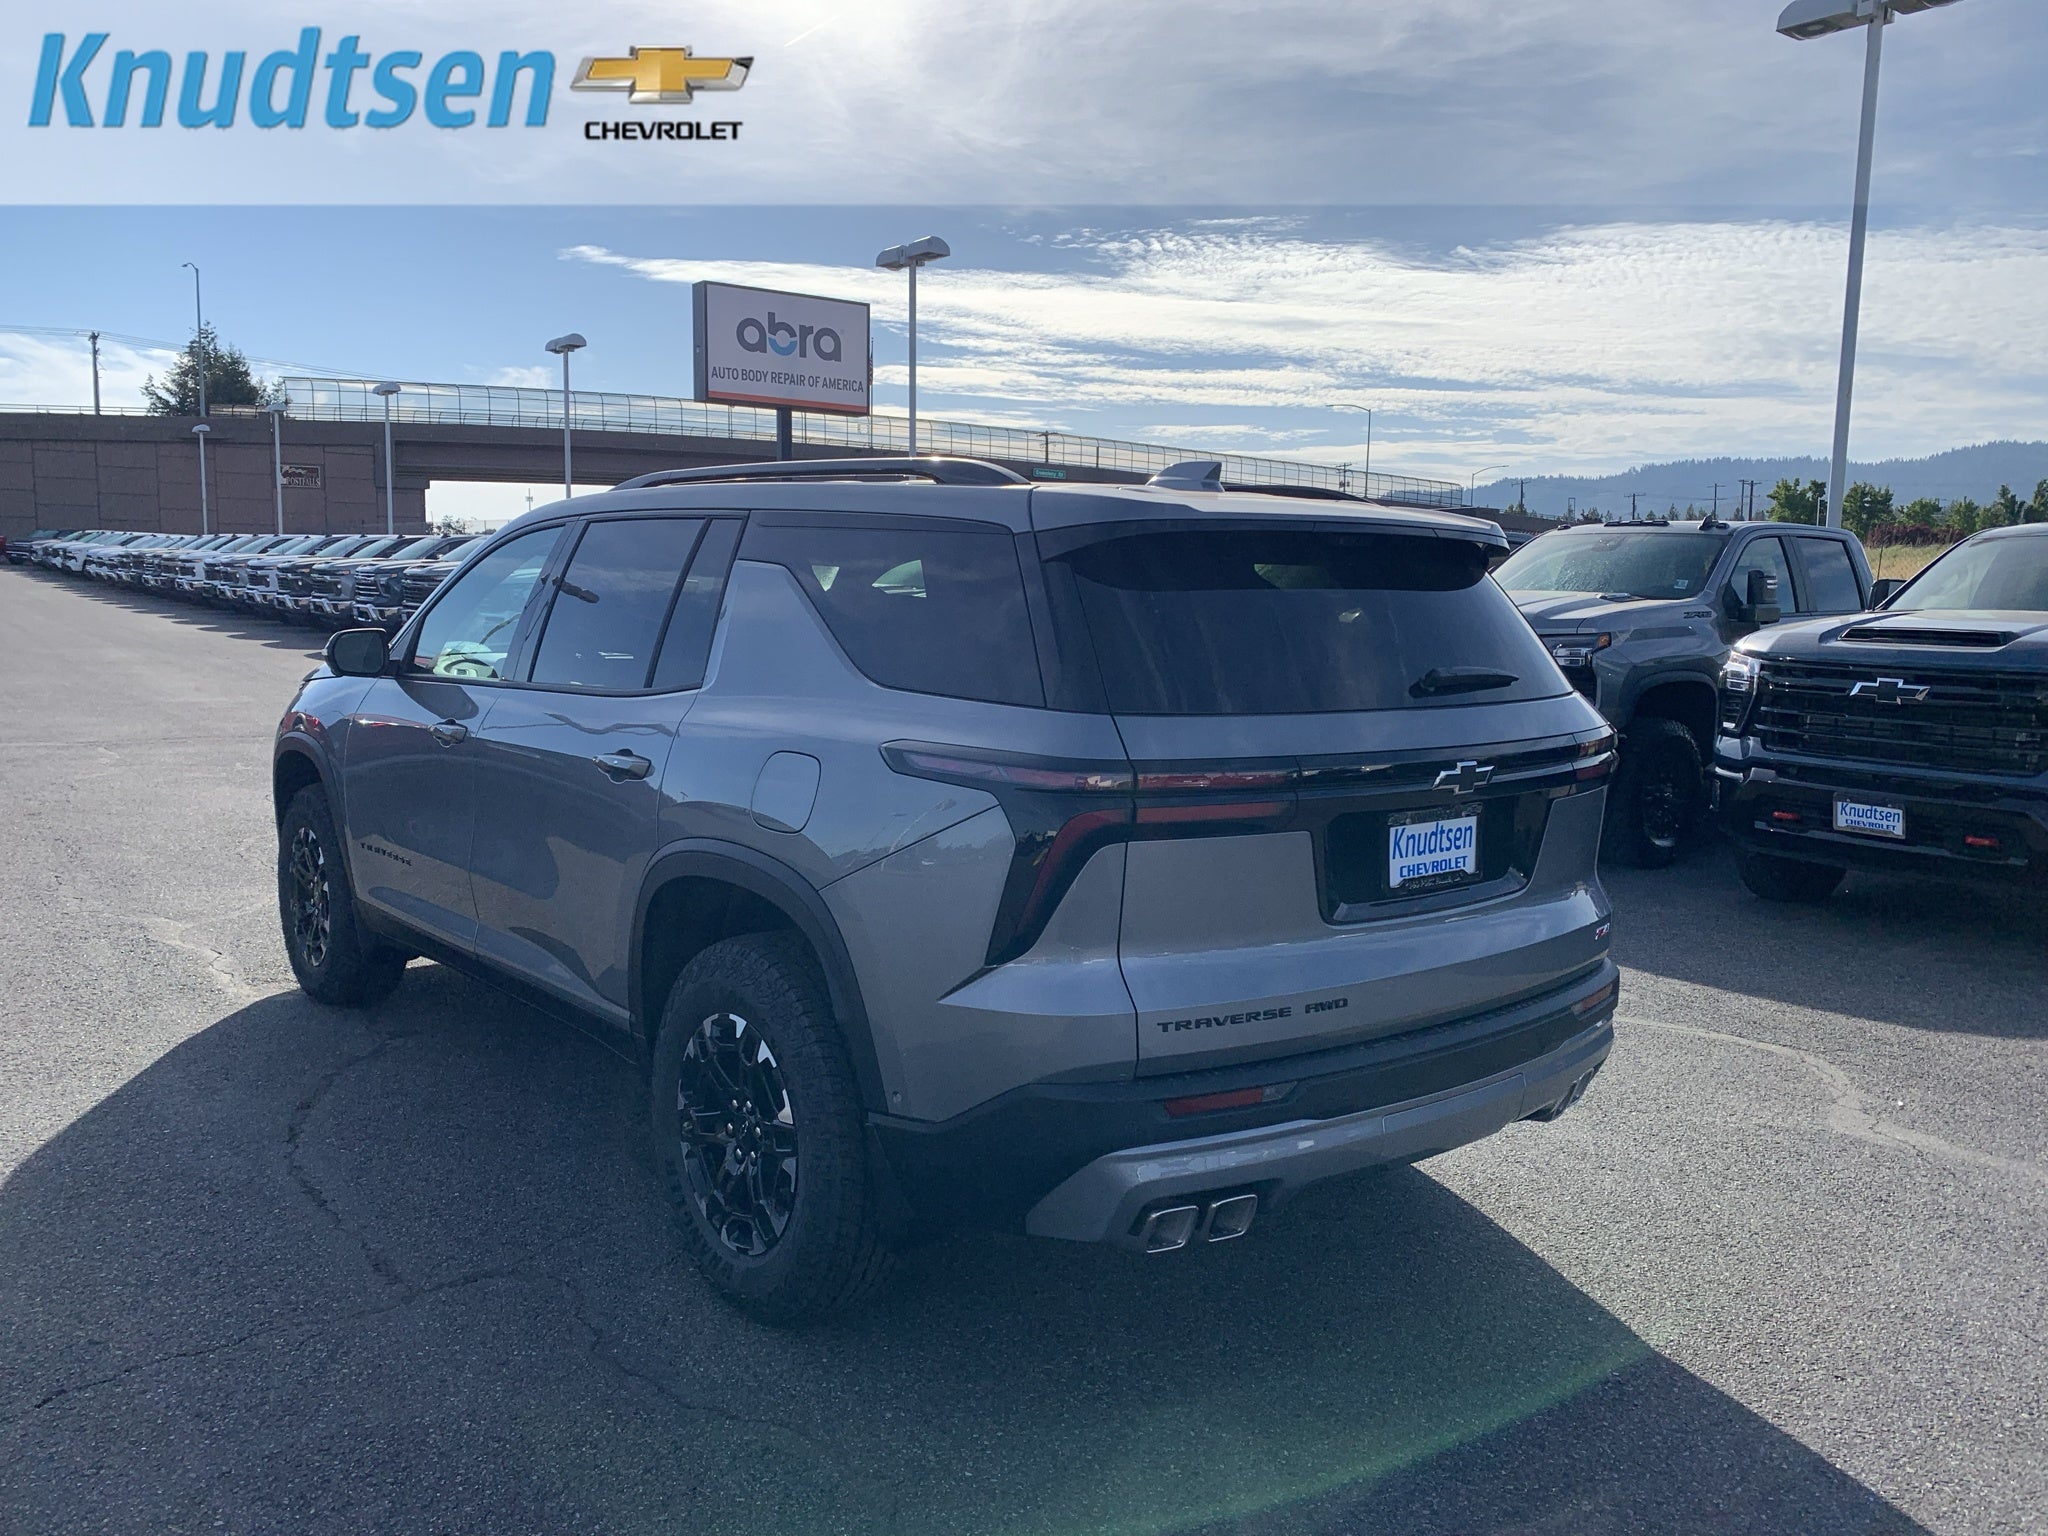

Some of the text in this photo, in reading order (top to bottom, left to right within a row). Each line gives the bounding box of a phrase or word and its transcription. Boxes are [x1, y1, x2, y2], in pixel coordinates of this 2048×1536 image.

[735, 311, 842, 362] abra
[711, 366, 864, 393] AUTO BODY REPAIR OF AMERICA
[1840, 803, 1900, 823] Knudtsen
[1845, 819, 1897, 831] CHEVROLET
[1392, 821, 1473, 860] Knudtsen
[1399, 855, 1468, 878] CHEVROLET
[1157, 997, 1349, 1033] TRAVERSE AWD
